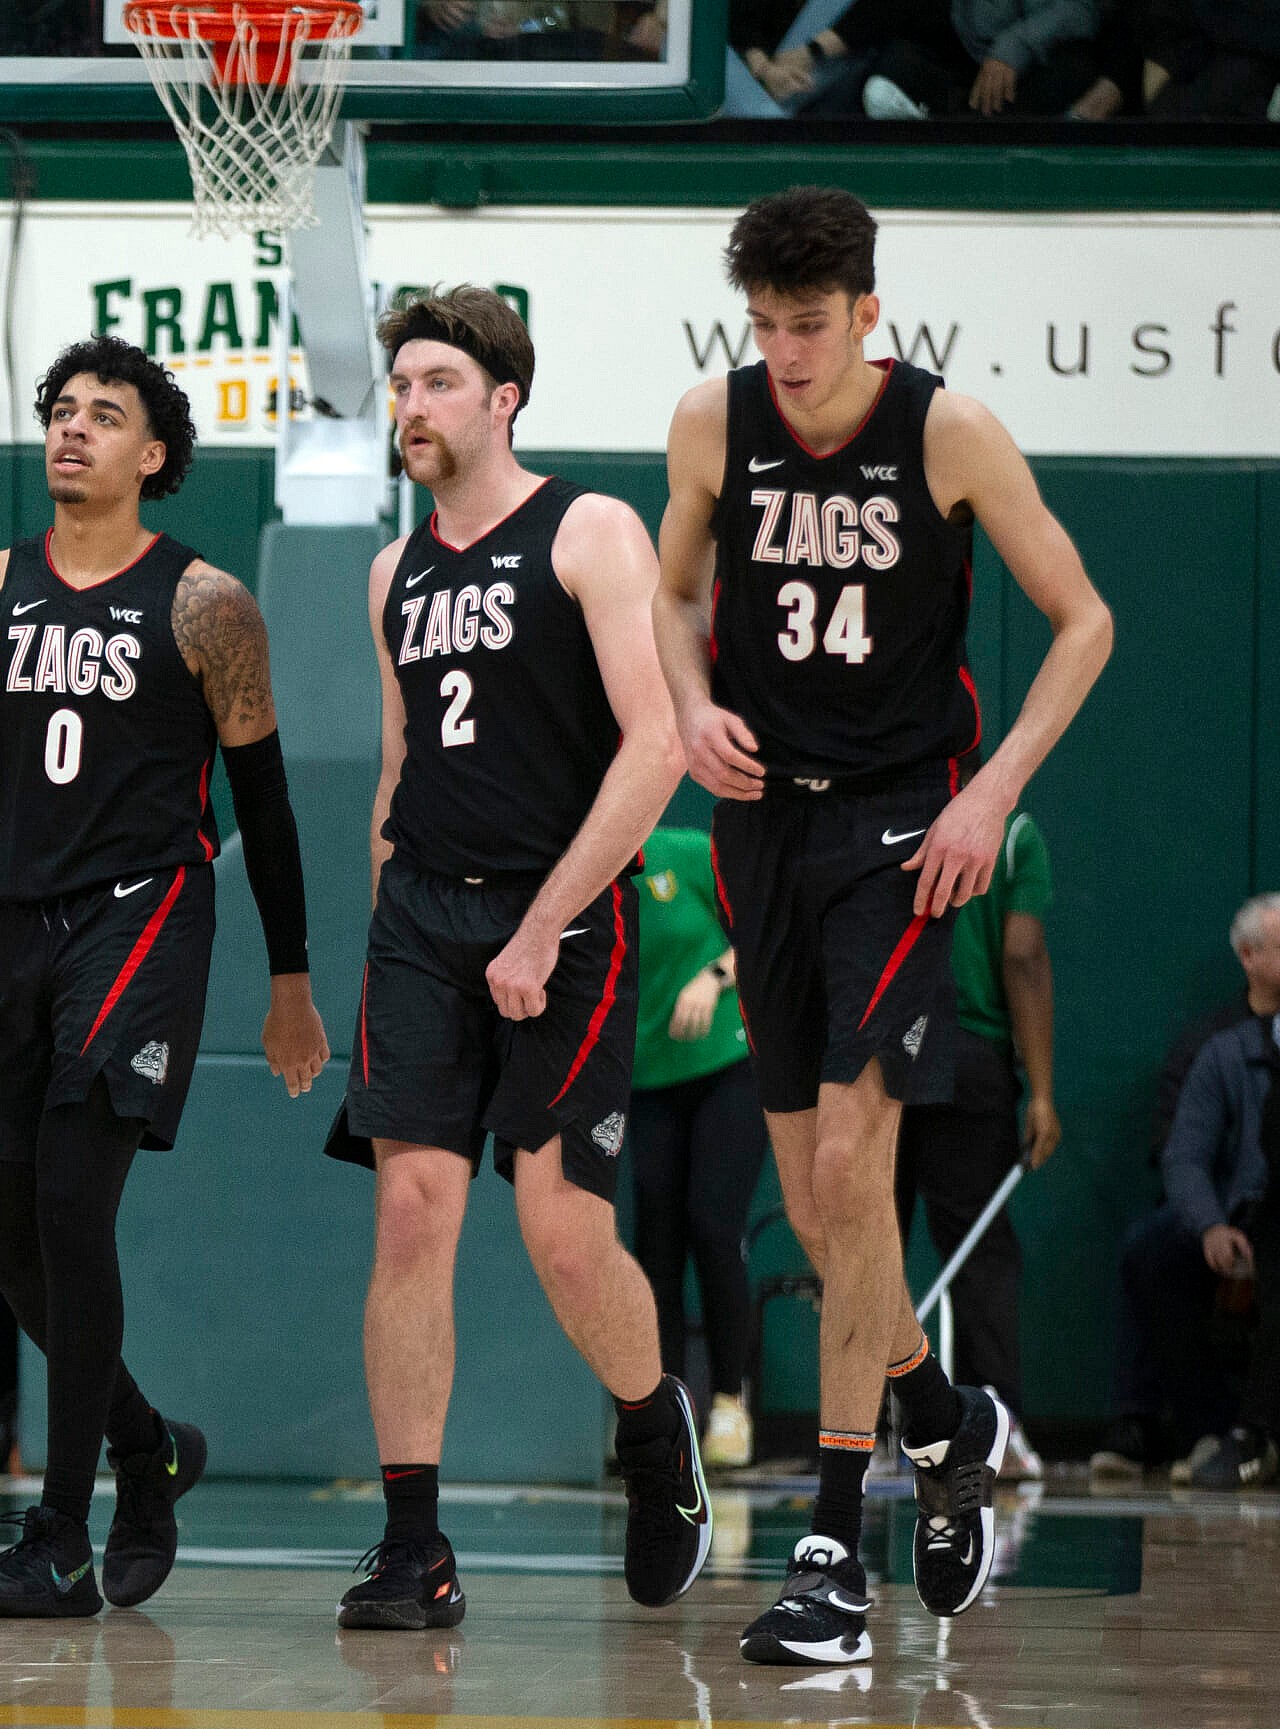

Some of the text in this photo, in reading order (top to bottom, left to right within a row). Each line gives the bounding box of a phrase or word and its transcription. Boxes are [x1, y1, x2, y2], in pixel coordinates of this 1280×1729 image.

[859, 465, 898, 481] WCC
[490, 556, 522, 568] WCC
[750, 489, 900, 570] ZAGS
[398, 582, 515, 666] ZAGS
[776, 580, 873, 664] 34
[6, 624, 141, 701] ZAGS
[44, 708, 83, 785] 0
[439, 669, 475, 748] 2
